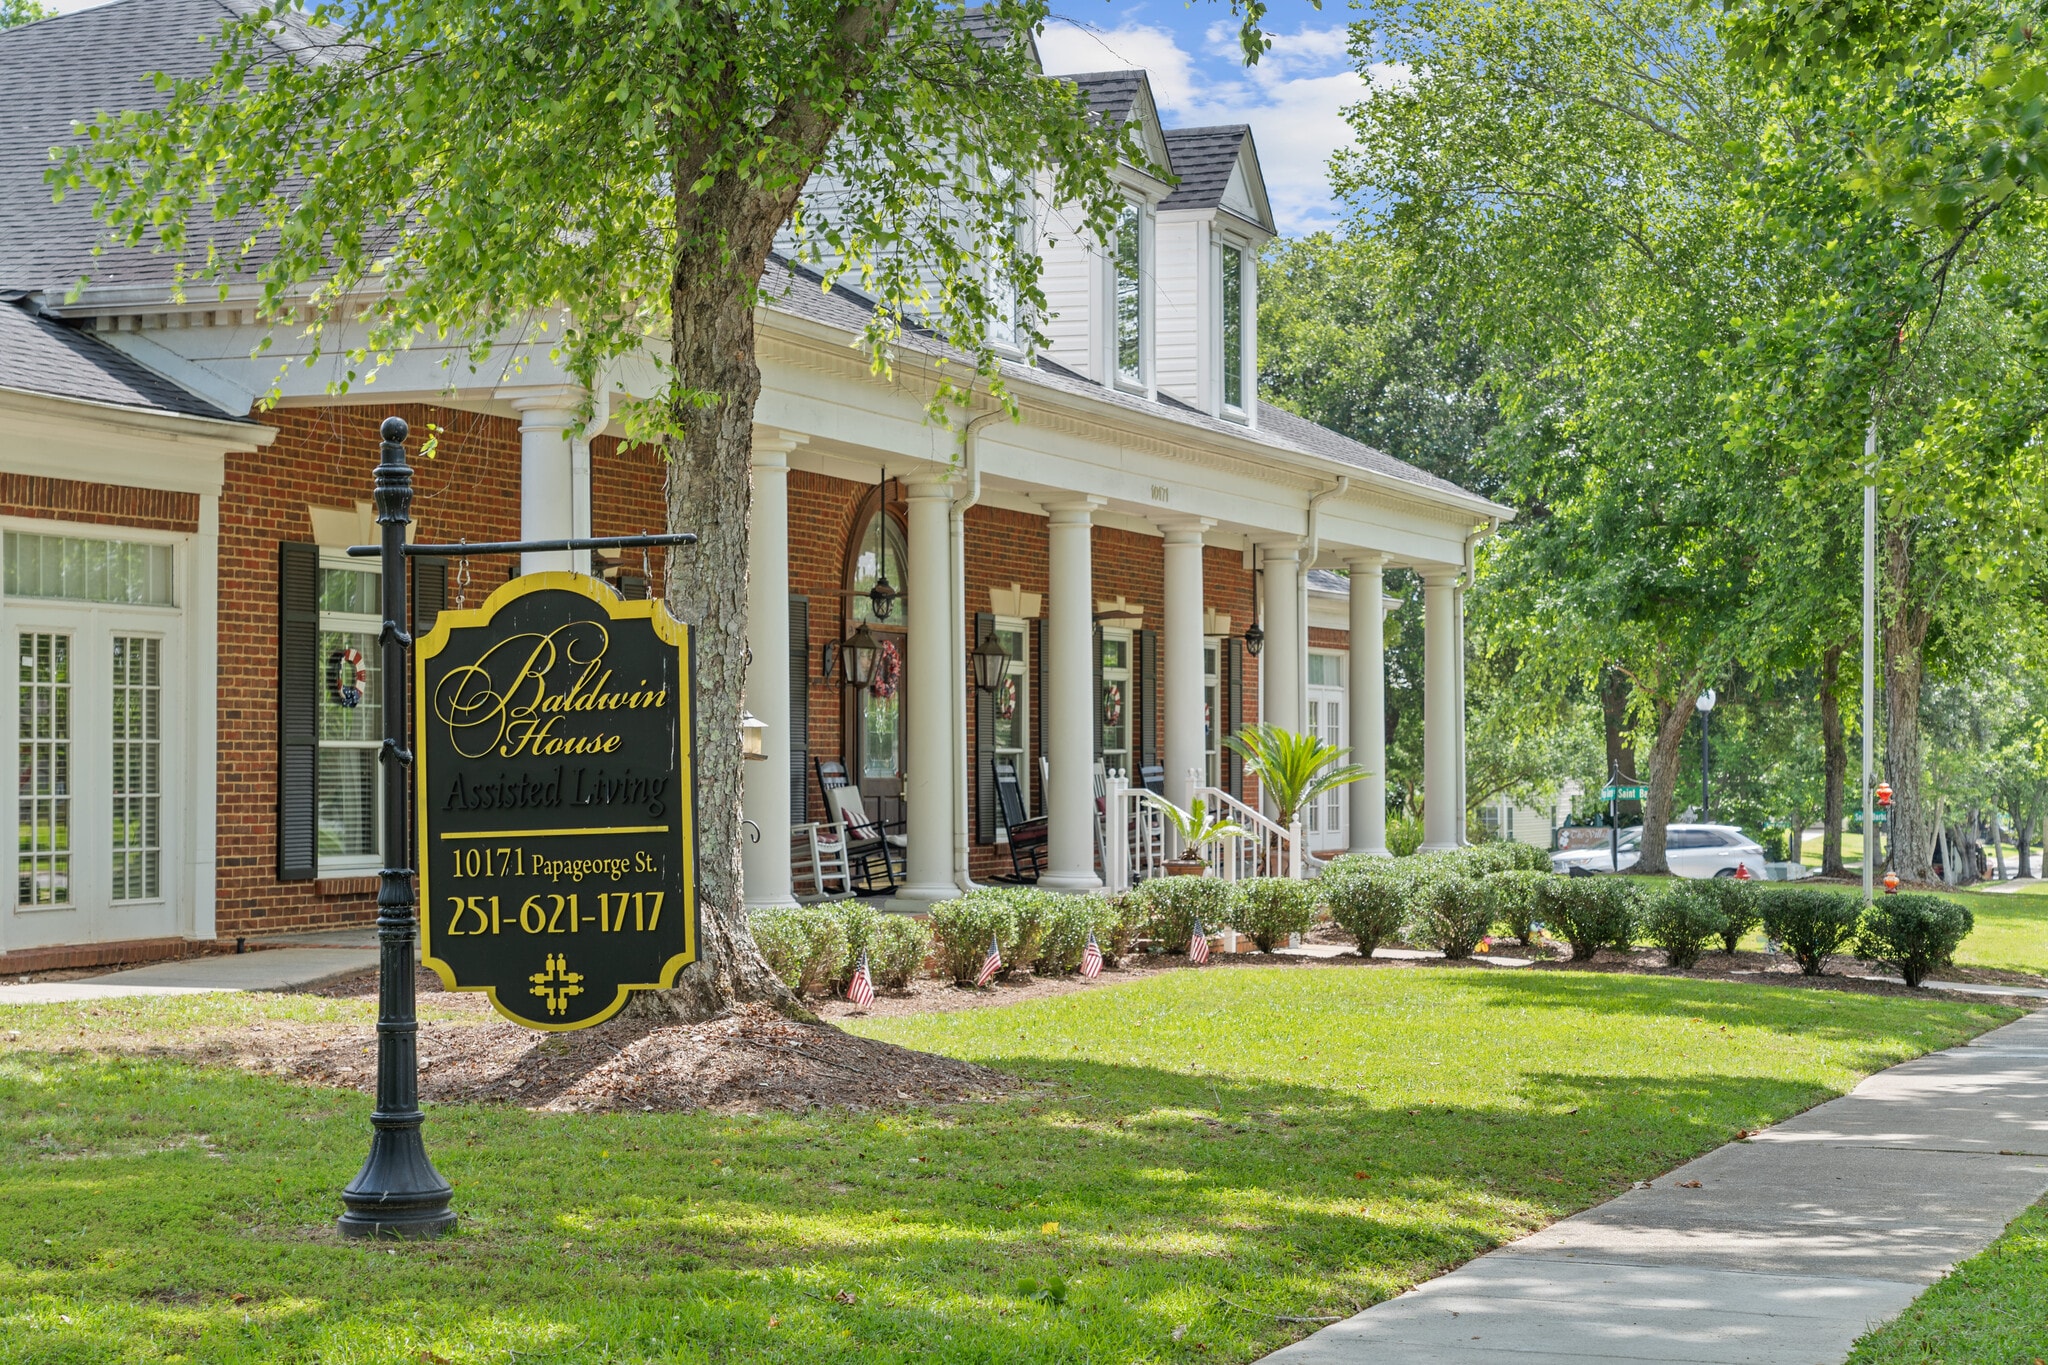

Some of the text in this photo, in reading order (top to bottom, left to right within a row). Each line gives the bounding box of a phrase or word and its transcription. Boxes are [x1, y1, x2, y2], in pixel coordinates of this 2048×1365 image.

[1151, 484, 1169, 503] 10171
[434, 620, 667, 758] Baldwin
[500, 714, 622, 758] House
[442, 765, 669, 818] Assisted Living
[1618, 788, 1636, 799] Saint
[452, 847, 658, 882] 10171 Papageorge St.
[447, 891, 665, 936] 251-621-1717
